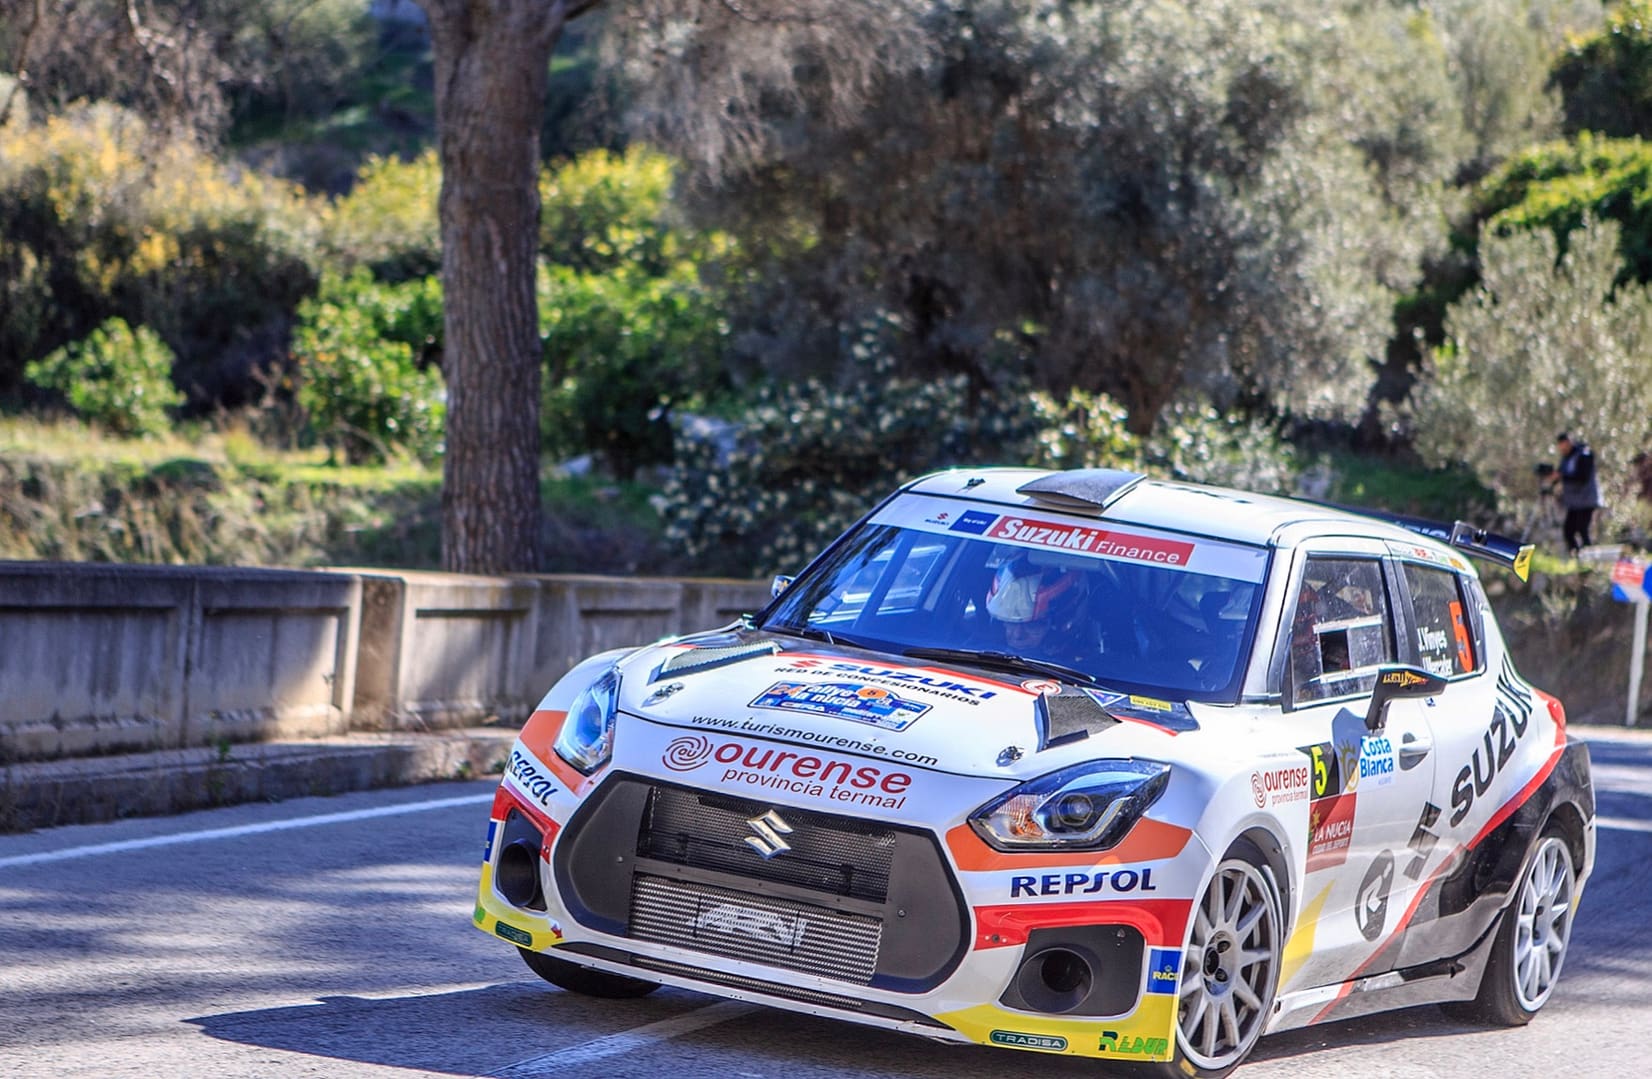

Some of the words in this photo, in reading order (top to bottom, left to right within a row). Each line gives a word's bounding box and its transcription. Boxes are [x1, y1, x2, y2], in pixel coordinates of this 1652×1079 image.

[998, 517, 1100, 552] Suzuki
[1095, 540, 1180, 564] Finance
[1449, 601, 1473, 673] 5
[828, 663, 999, 700] SUZUKI
[836, 672, 981, 707] CONCESIONARIOS
[691, 713, 939, 767] www.turismourense.com
[1360, 737, 1392, 757] Costa
[507, 750, 558, 806] REPSOL
[714, 742, 912, 794] ourense
[1263, 767, 1308, 792] ourense
[1310, 745, 1328, 796] 5
[1360, 757, 1394, 778] Blanca
[721, 767, 822, 797] provincia
[829, 783, 906, 810] termal
[1314, 826, 1324, 842] LA
[1010, 868, 1157, 898] REPSOL
[996, 1033, 1062, 1048] TRADISA
